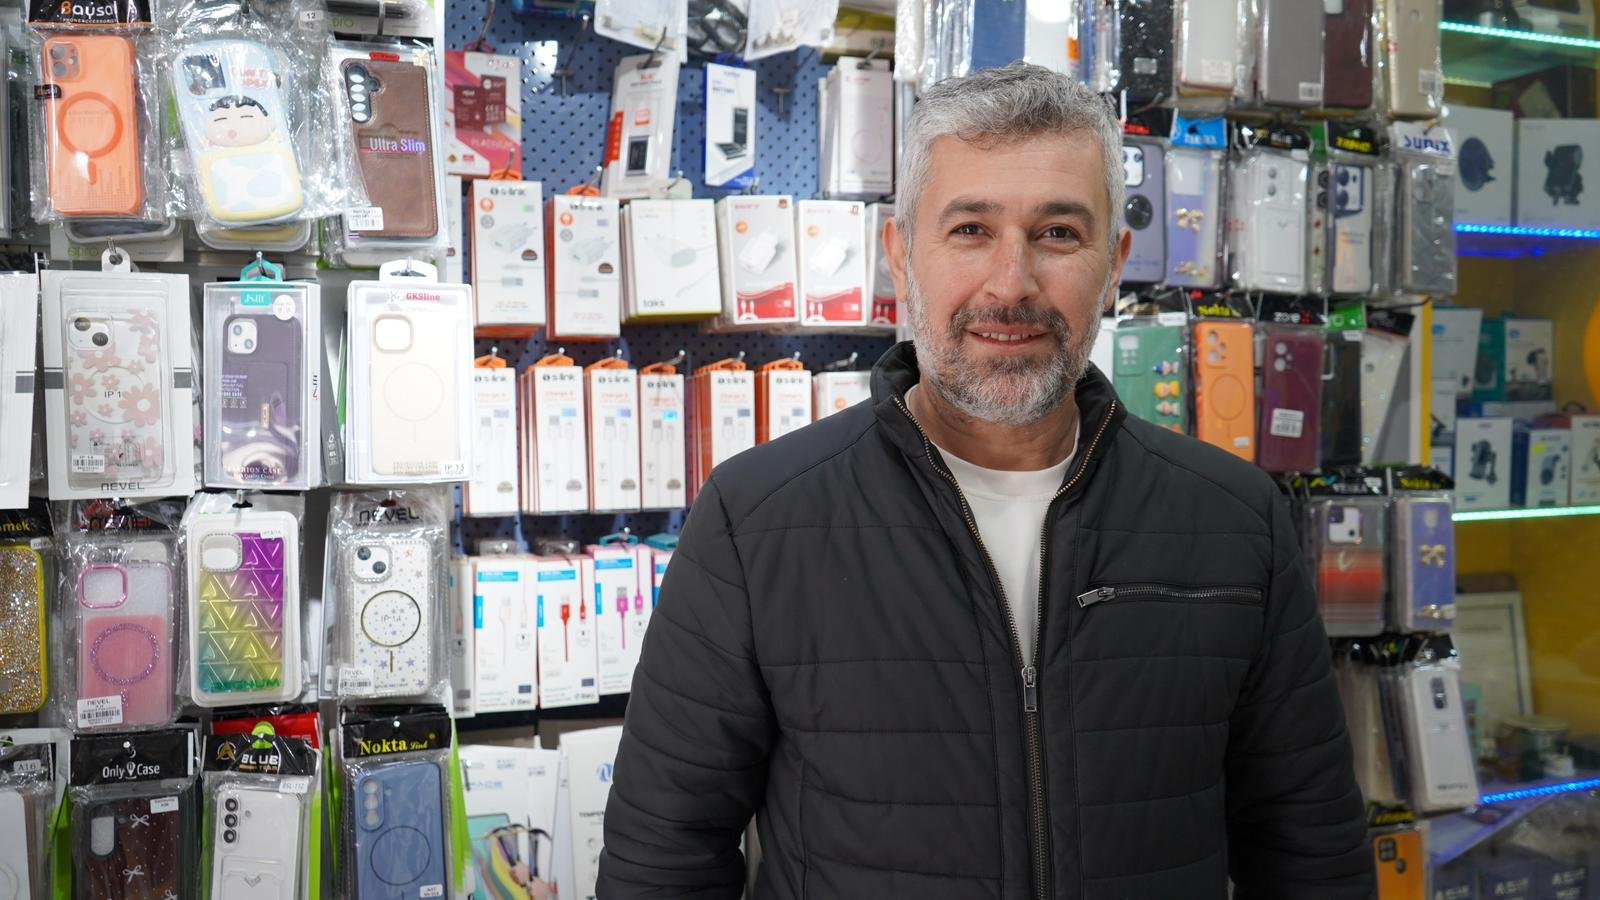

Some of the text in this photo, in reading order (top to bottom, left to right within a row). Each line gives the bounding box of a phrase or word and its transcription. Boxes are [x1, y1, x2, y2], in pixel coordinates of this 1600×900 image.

[369, 137, 425, 152] Ultra Slim
[104, 390, 114, 399] IP
[360, 738, 408, 756] Nokta
[241, 753, 279, 765] BLUE
[102, 763, 160, 780] Only Case
